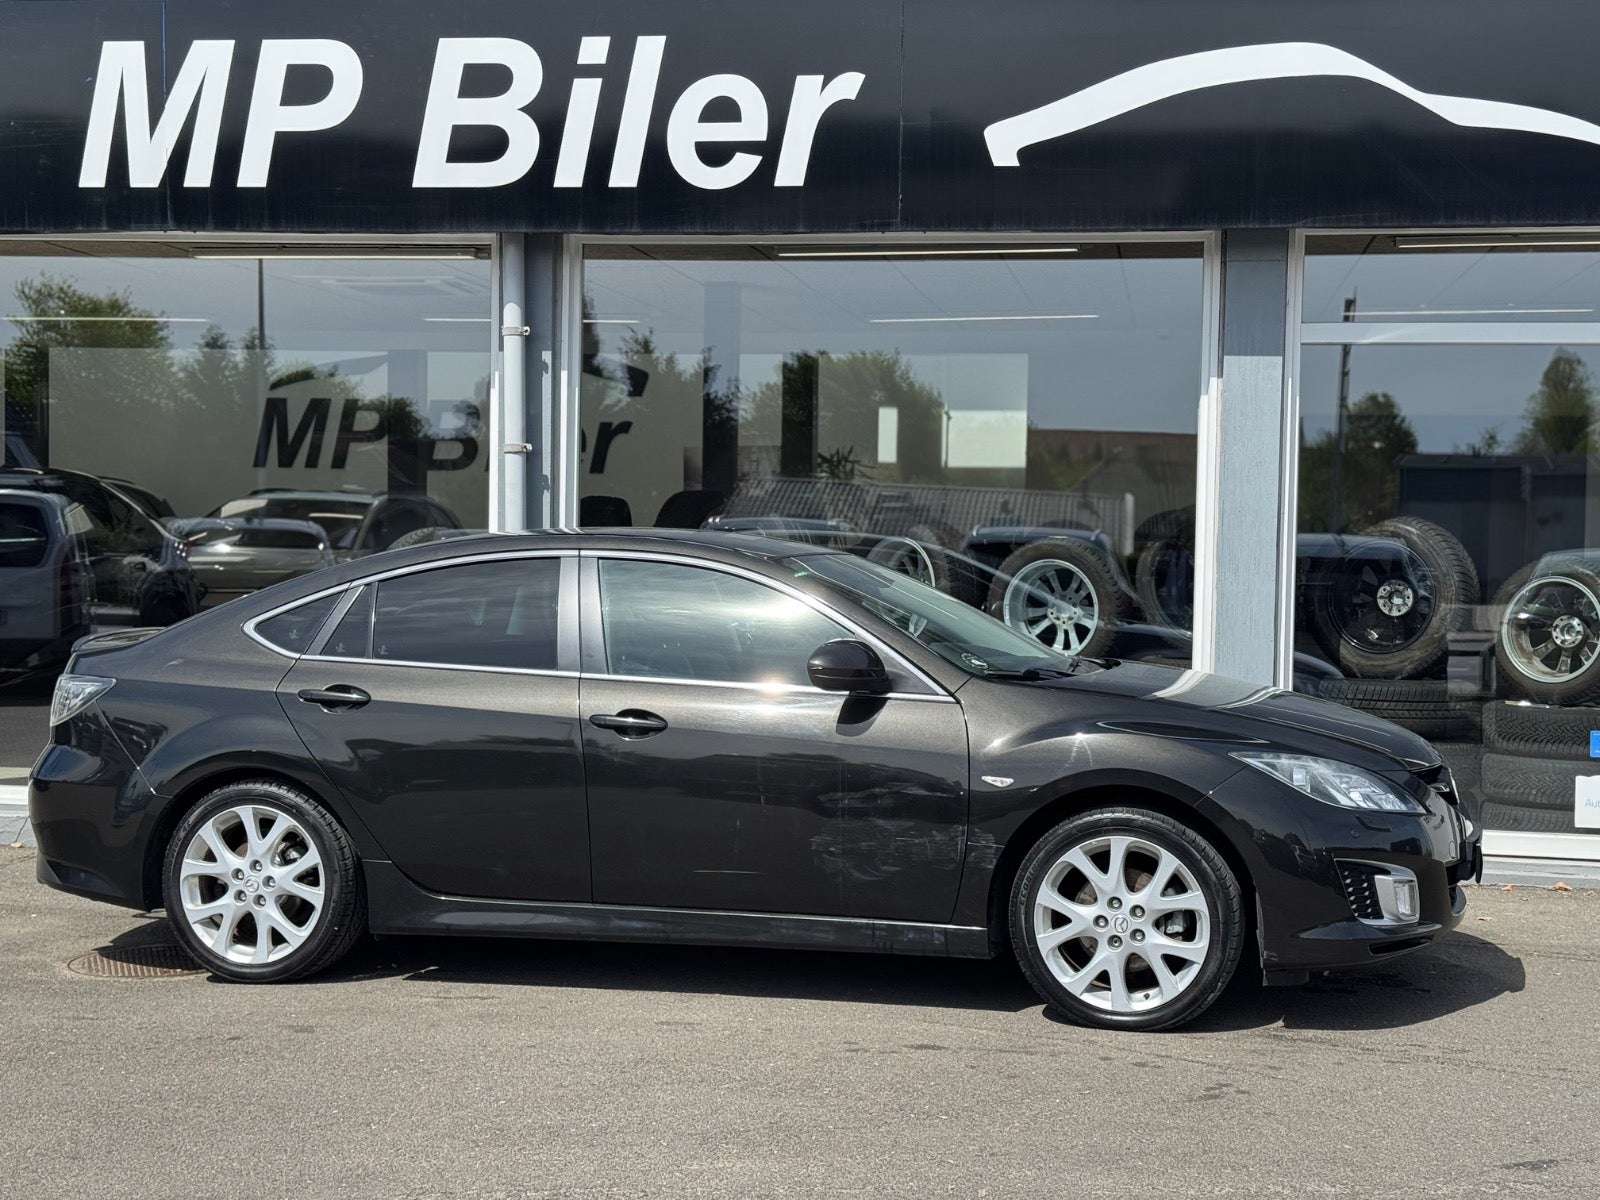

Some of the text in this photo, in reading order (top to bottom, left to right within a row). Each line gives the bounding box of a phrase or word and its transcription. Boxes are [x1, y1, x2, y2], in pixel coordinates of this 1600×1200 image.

[79, 35, 866, 190] MP Biler
[252, 397, 389, 469] MP
